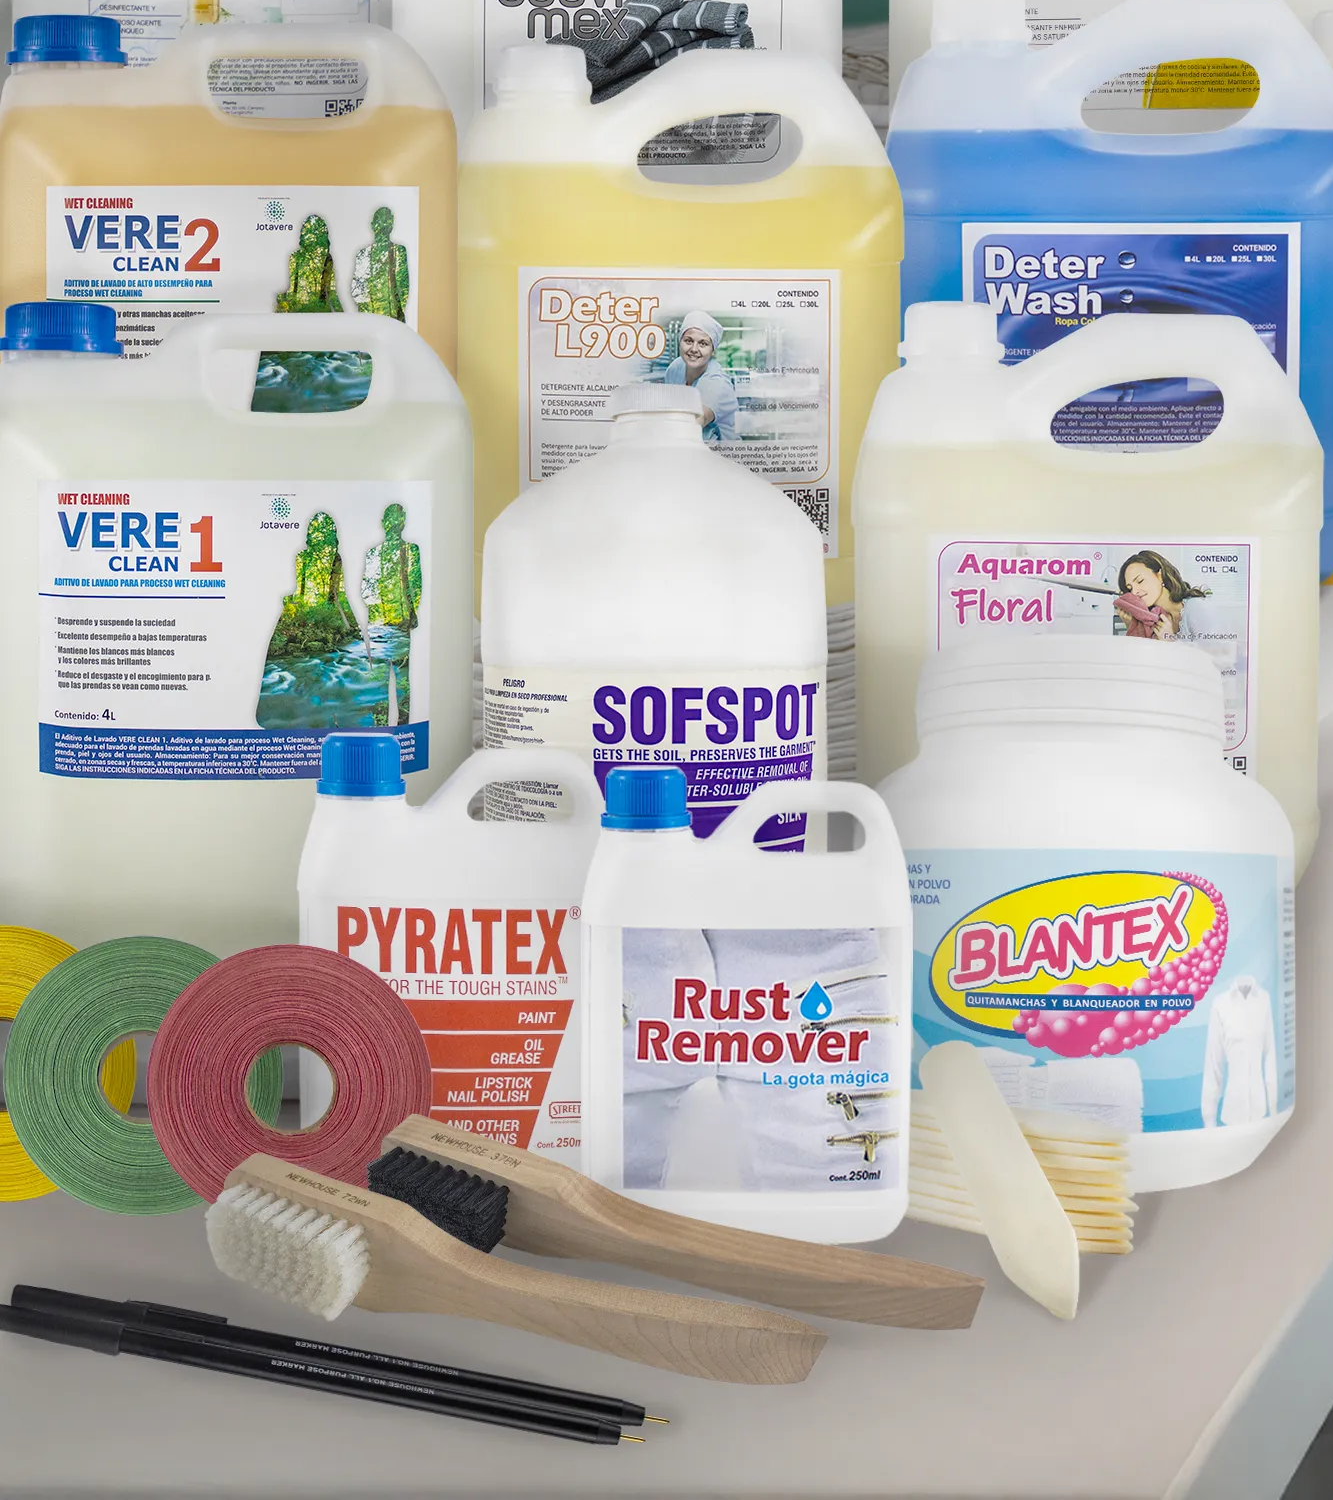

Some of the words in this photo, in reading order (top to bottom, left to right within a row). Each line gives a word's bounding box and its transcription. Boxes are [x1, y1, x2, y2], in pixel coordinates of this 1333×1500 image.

[527, 7, 629, 40] mex
[64, 198, 84, 209] WET
[86, 197, 133, 209] CLEANING
[64, 214, 181, 251] VERE
[256, 222, 293, 232] Jotavere
[184, 218, 220, 272] 2
[1233, 244, 1277, 252] CONTENIDO
[113, 256, 179, 272] CLEAN
[984, 245, 1105, 280] Deter
[64, 279, 89, 288] ADITIVO
[91, 280, 99, 288] DE
[100, 280, 126, 288] LAVADO
[127, 280, 135, 288] DE
[137, 280, 153, 288] ALTO
[154, 278, 193, 288] DESEMPEÑO
[195, 279, 213, 288] PARA
[110, 289, 143, 297] CLEANING
[984, 281, 1103, 316] Wash
[539, 288, 659, 323] Deter
[1055, 317, 1079, 326] Ropa
[554, 323, 666, 359] L900
[58, 493, 78, 505] WET
[79, 493, 130, 506] CLEANING
[57, 511, 180, 550] VERE
[260, 520, 300, 530] Jotavere
[190, 515, 223, 573] 1
[108, 556, 179, 572] CLEAN
[957, 553, 1091, 580] Aquarom
[1195, 555, 1238, 563] CONTENIDO
[54, 578, 80, 587] ADITIVO
[81, 578, 90, 587] DE
[91, 578, 118, 588] LAVADO
[120, 579, 139, 588] PARA
[140, 579, 173, 588] PROCESO
[175, 578, 189, 588] WET
[191, 578, 226, 589] CLEANING
[950, 588, 1053, 625] Floral
[57, 617, 92, 627] Desprende
[100, 618, 134, 628] suspende
[135, 618, 141, 627] la
[143, 618, 176, 627] suciedad
[57, 632, 88, 641] Excelente
[90, 633, 130, 642] desempeño
[138, 633, 157, 642] bajas
[159, 634, 207, 643] temperaturas
[503, 678, 525, 688] PELIGRO
[55, 709, 100, 721] Contenido:
[102, 708, 116, 721] 4L
[592, 683, 817, 745] SOFSPOT
[593, 749, 623, 761] GETS
[627, 749, 650, 761] THE
[653, 749, 687, 763] SOIL,
[690, 747, 756, 762] PRESERVES
[759, 746, 777, 759] THE
[780, 742, 814, 756] GARMENT
[696, 767, 756, 780] EFFECTIVE
[758, 764, 798, 777] REMOVAL
[800, 761, 809, 772] OF
[337, 905, 568, 975] PYRATEX
[952, 889, 1189, 985] BLANTEX
[416, 980, 443, 995] THE
[449, 980, 501, 996] TOUGH
[506, 980, 557, 996] STAINS
[673, 977, 791, 1021] Rust
[967, 995, 1046, 1007] QUITAMANCHAS
[1051, 998, 1057, 1007] Y
[1063, 998, 1140, 1009] BLANQUEADOR
[1145, 999, 1158, 1008] EN
[1162, 998, 1192, 1008] POLVO
[518, 1012, 556, 1024] PAINT
[524, 1039, 544, 1051] OIL
[636, 1020, 869, 1064] Remover
[490, 1052, 542, 1065] GREASE
[475, 1077, 533, 1089] LIPSTICK
[763, 1072, 783, 1086] La
[788, 1072, 825, 1089] gota
[830, 1070, 890, 1088] mágica
[447, 1090, 476, 1102] NAIL
[481, 1090, 529, 1102] POLISH
[446, 1120, 473, 1132] AND
[476, 1119, 520, 1132] OTHER
[431, 1132, 491, 1159] NEWHOUSE
[490, 1150, 522, 1169] 37BN
[829, 1174, 848, 1183] Cont.
[849, 1170, 881, 1182] 250ml
[285, 1172, 340, 1197] NEWHOUSE
[341, 1192, 371, 1207] 72WN
